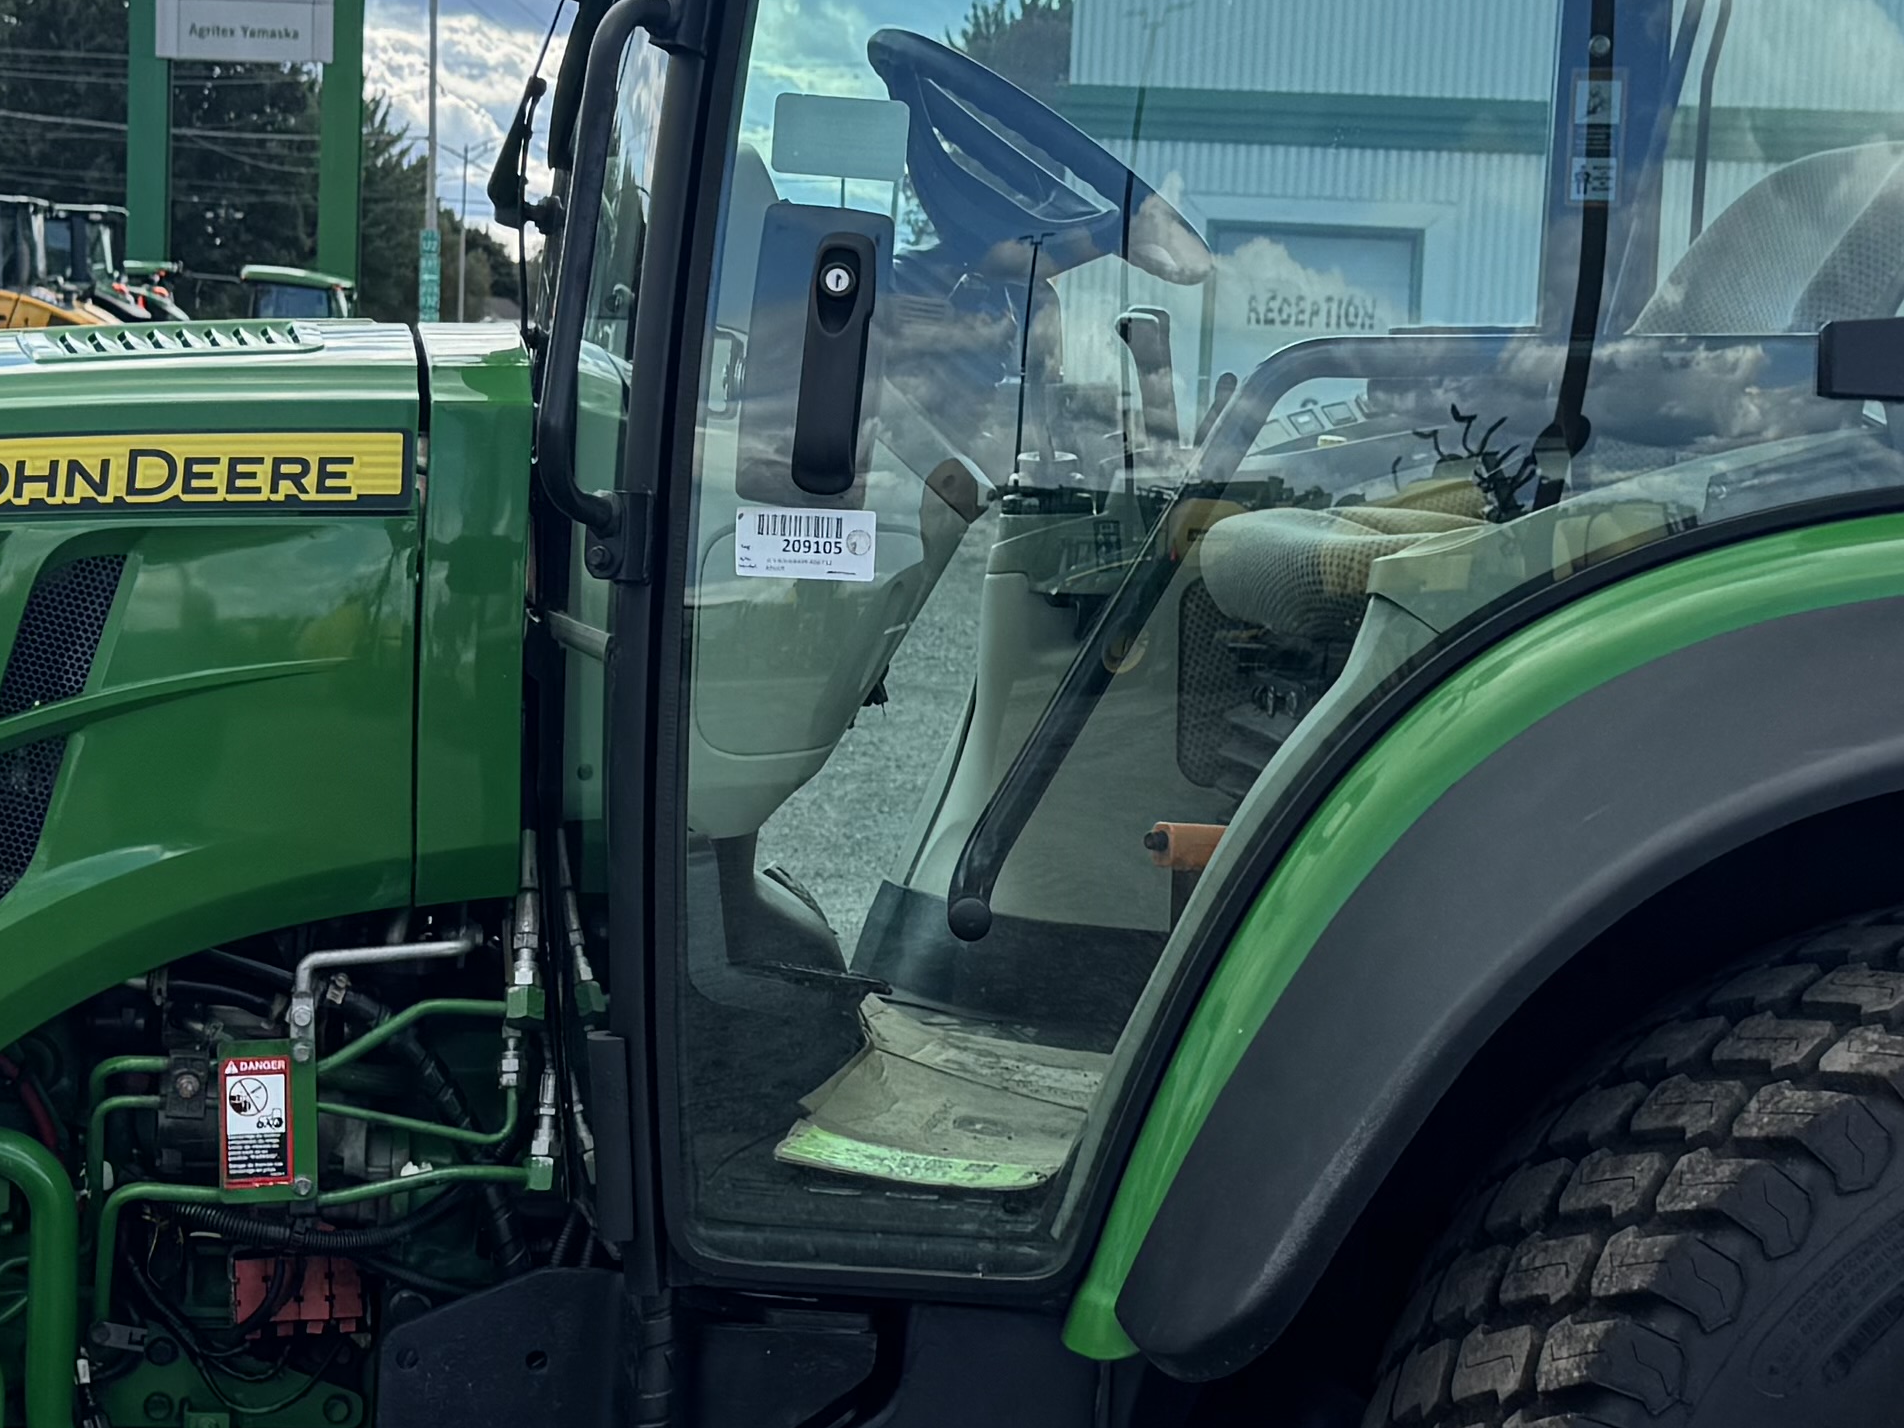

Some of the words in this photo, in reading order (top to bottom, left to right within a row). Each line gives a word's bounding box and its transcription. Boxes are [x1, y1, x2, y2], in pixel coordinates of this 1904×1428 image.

[124, 448, 355, 498] DEERE
[782, 538, 843, 555] 209105
[239, 1059, 286, 1072] DANGER
